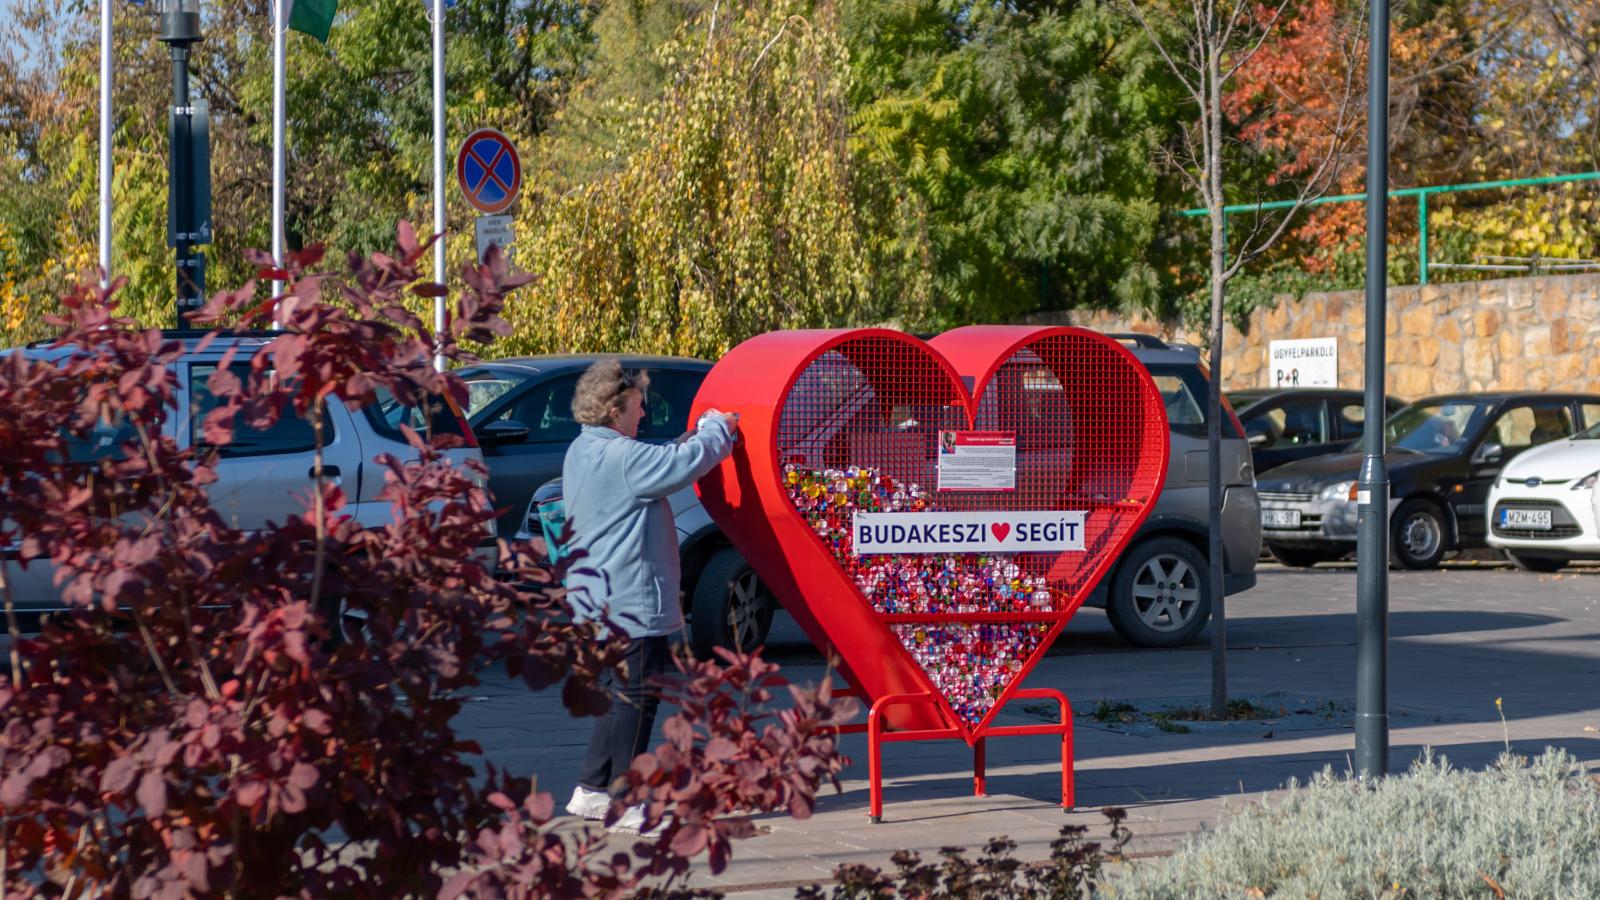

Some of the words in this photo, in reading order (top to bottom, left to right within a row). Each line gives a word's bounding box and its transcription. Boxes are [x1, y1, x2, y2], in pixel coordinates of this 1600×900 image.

[1277, 368, 1299, 388] P+R
[1509, 512, 1549, 524] MZM-495
[859, 524, 986, 544] BUDAKESZI
[1015, 518, 1079, 542] SEGÍT
